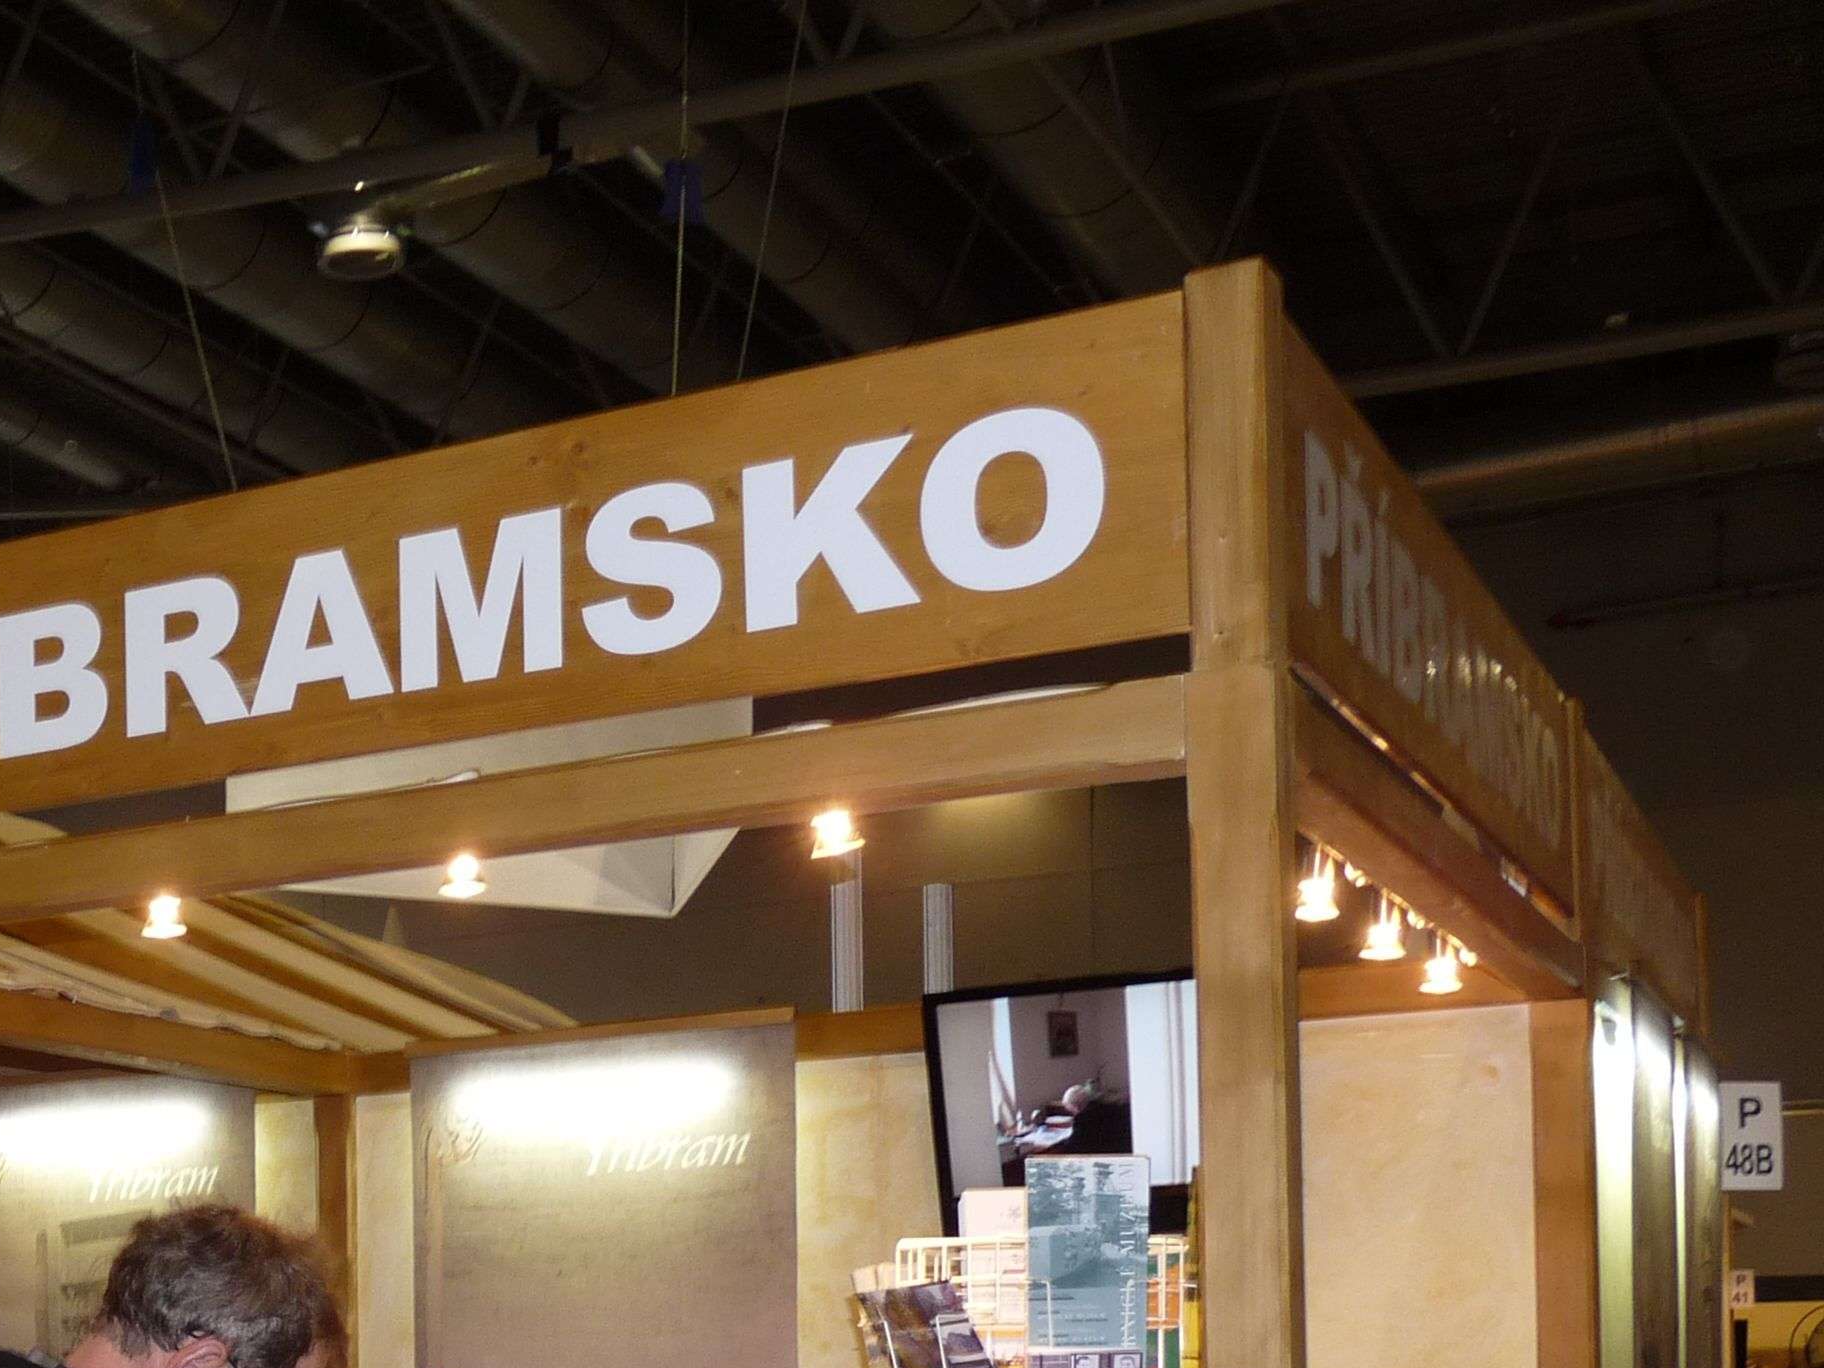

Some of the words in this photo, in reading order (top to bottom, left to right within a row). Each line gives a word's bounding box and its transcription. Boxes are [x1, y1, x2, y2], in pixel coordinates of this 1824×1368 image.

[1739, 1098, 1762, 1128] P
[1726, 1143, 1774, 1177] 48B
[1736, 1273, 1747, 1287] P
[1732, 1291, 1749, 1305] 41
